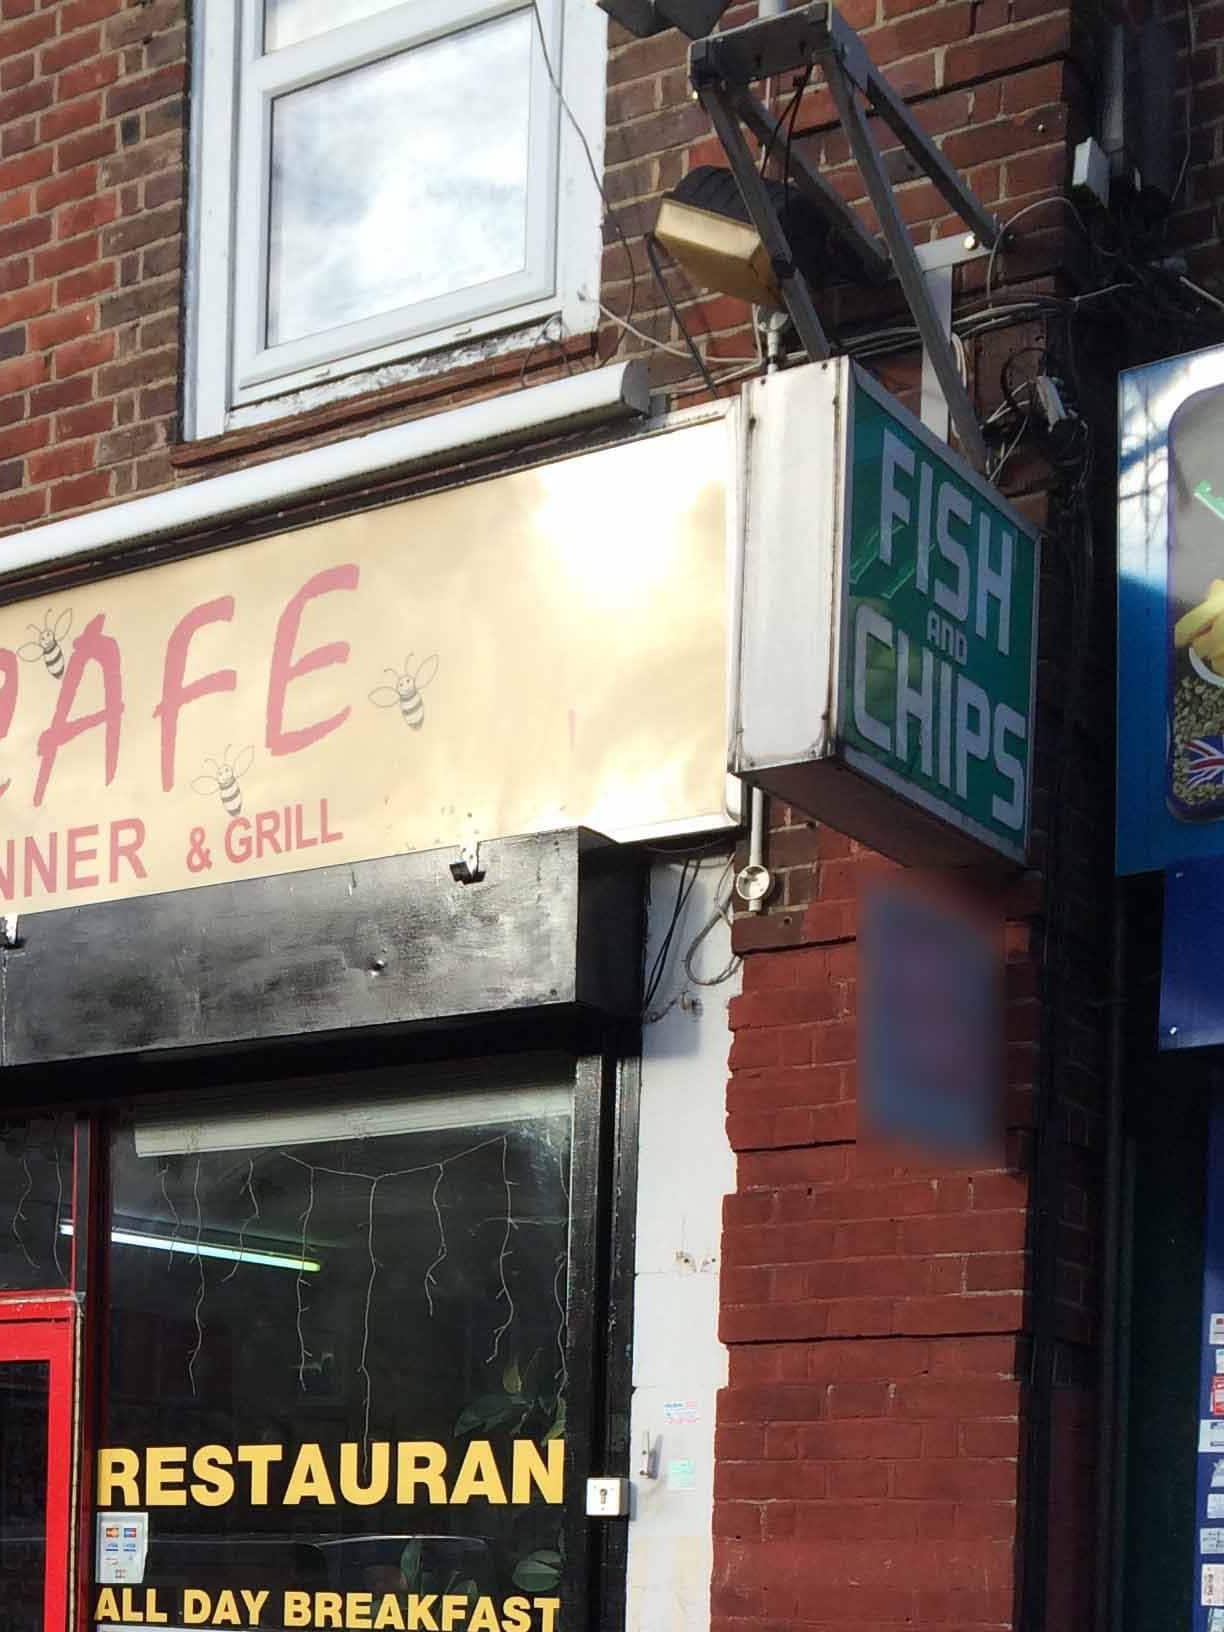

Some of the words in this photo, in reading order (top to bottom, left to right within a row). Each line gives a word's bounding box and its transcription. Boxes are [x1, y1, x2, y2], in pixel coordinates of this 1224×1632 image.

[878, 425, 1018, 657] FISH
[854, 603, 1027, 832] CHIPS
[186, 826, 213, 874] &
[224, 798, 344, 864] GRILL
[97, 1440, 565, 1507] RESTAURAN
[94, 1588, 168, 1623] ALL
[183, 1590, 270, 1625] DAY
